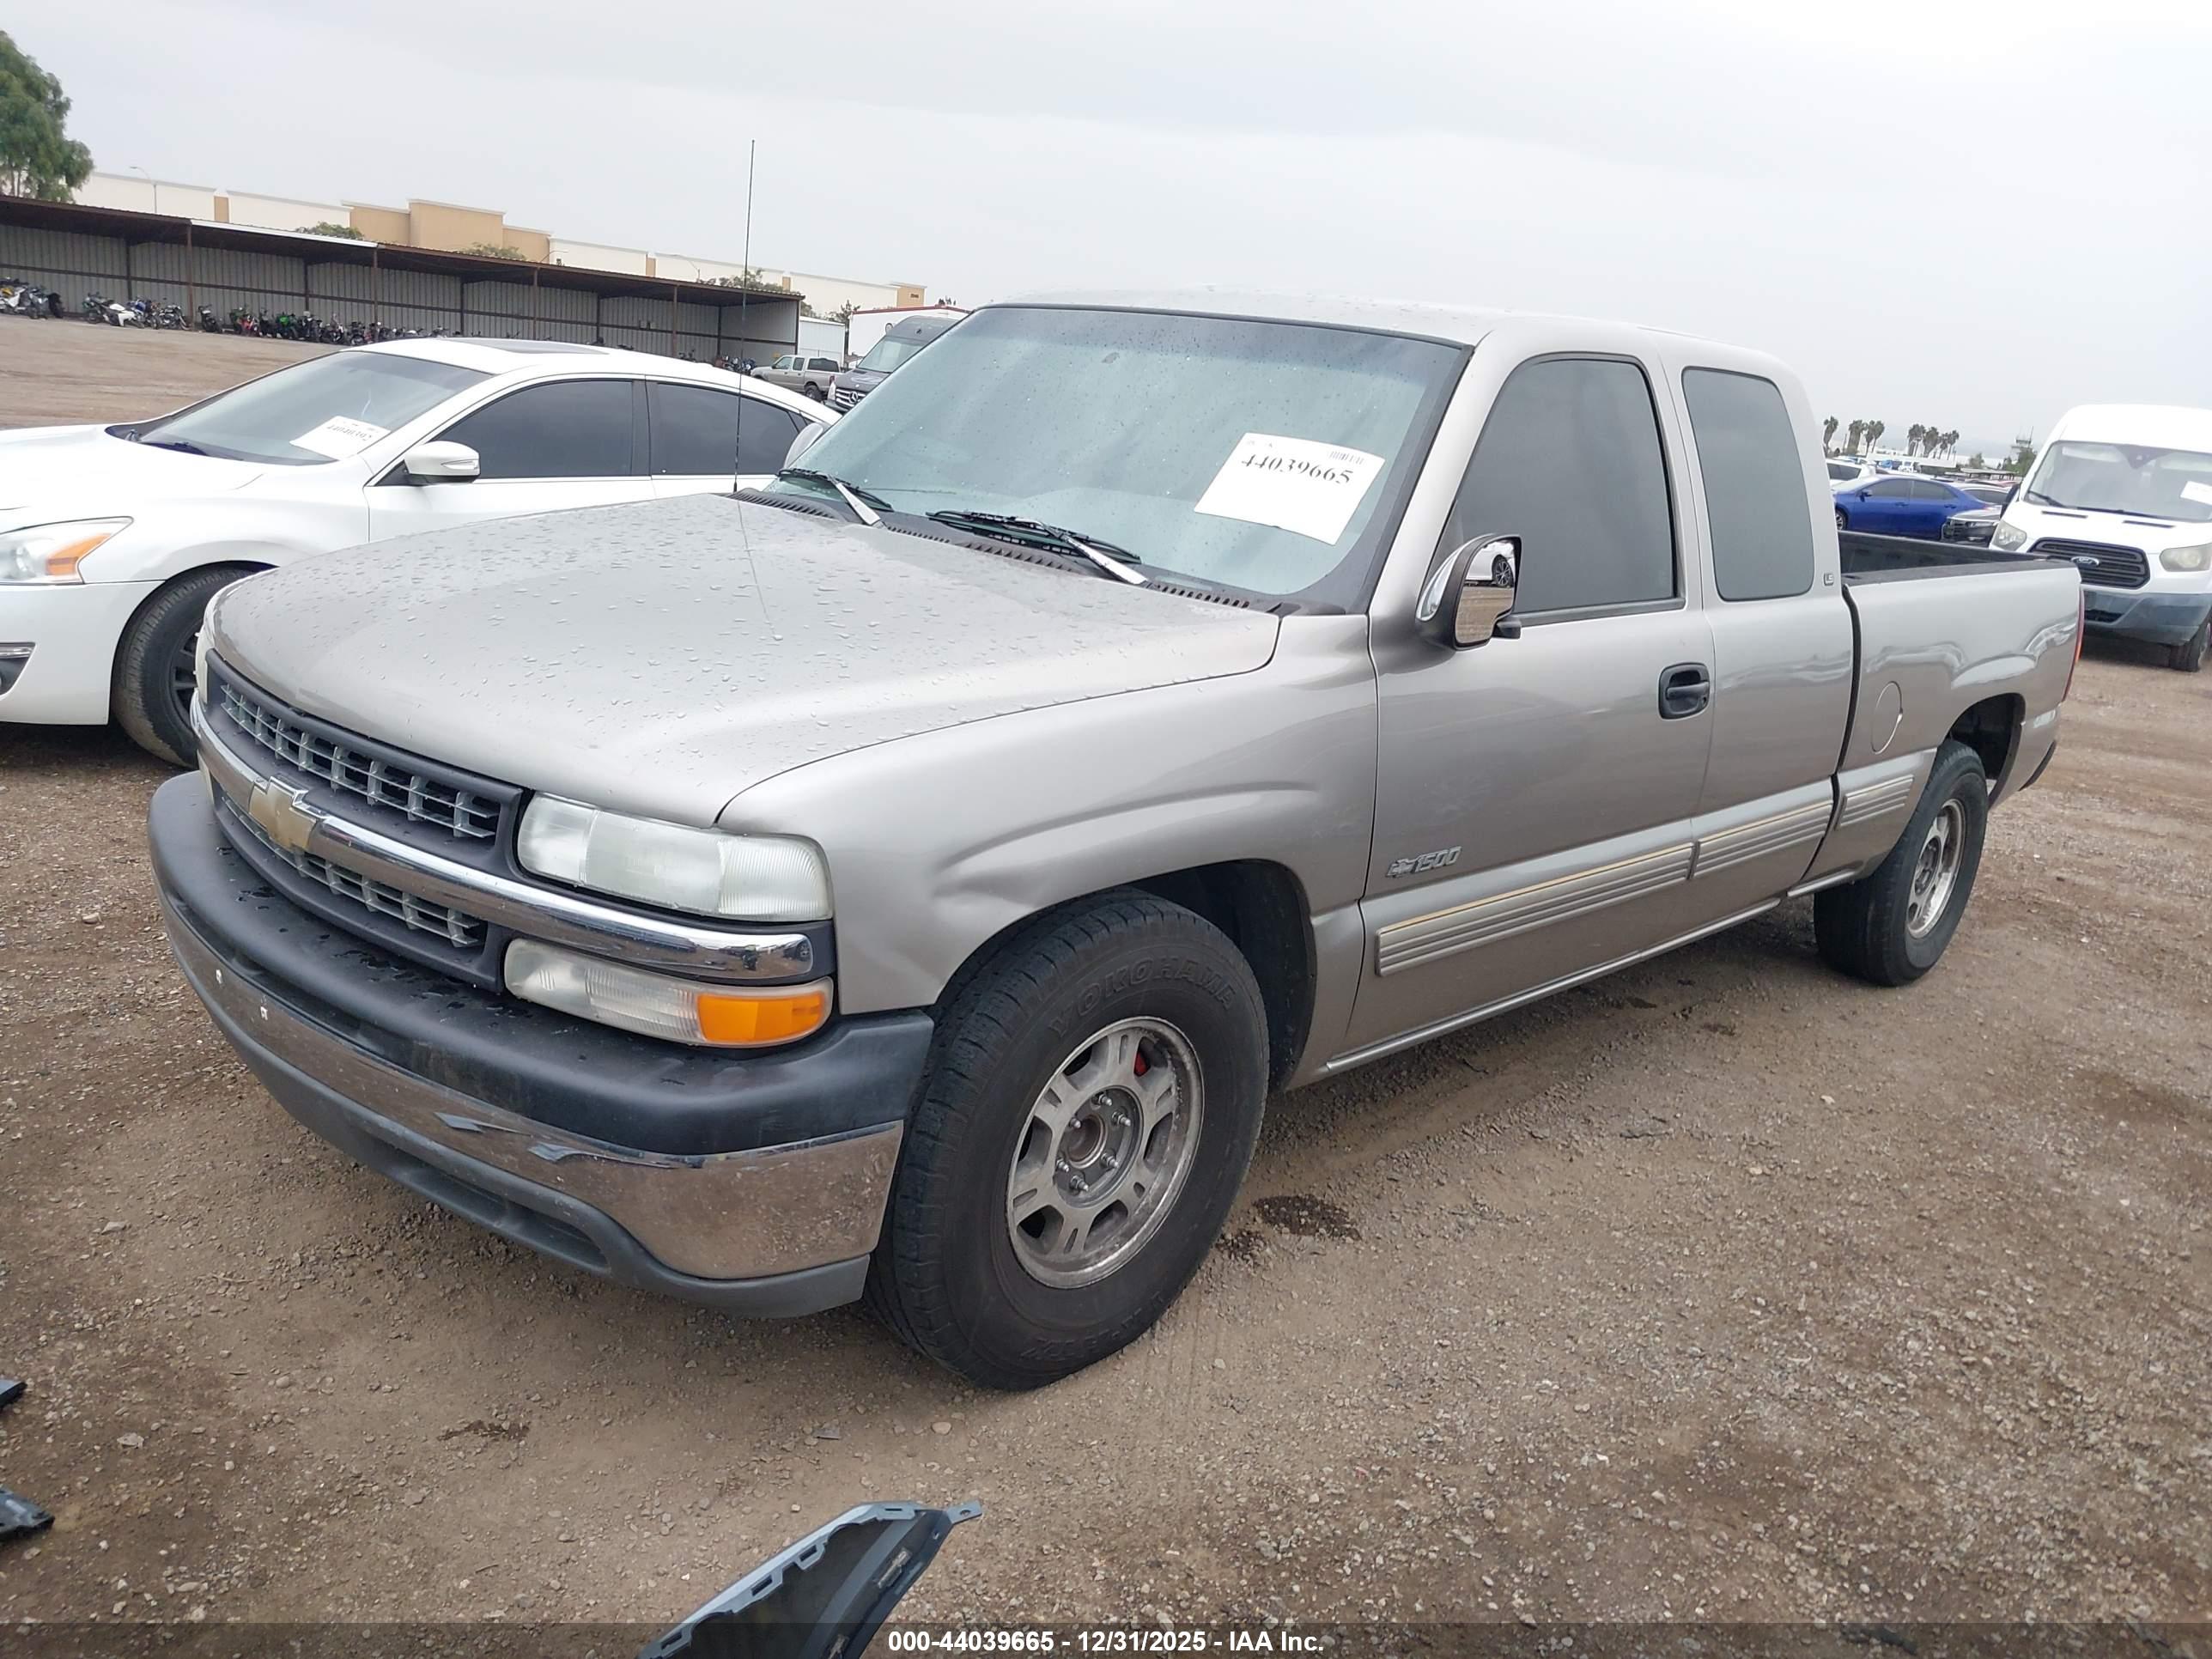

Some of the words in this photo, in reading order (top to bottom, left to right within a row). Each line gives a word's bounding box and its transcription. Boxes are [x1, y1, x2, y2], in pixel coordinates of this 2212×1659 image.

[1242, 453, 1354, 484] 44039665
[1414, 845, 1463, 874] 1500
[1048, 956, 1237, 1036] YOKOHAMA
